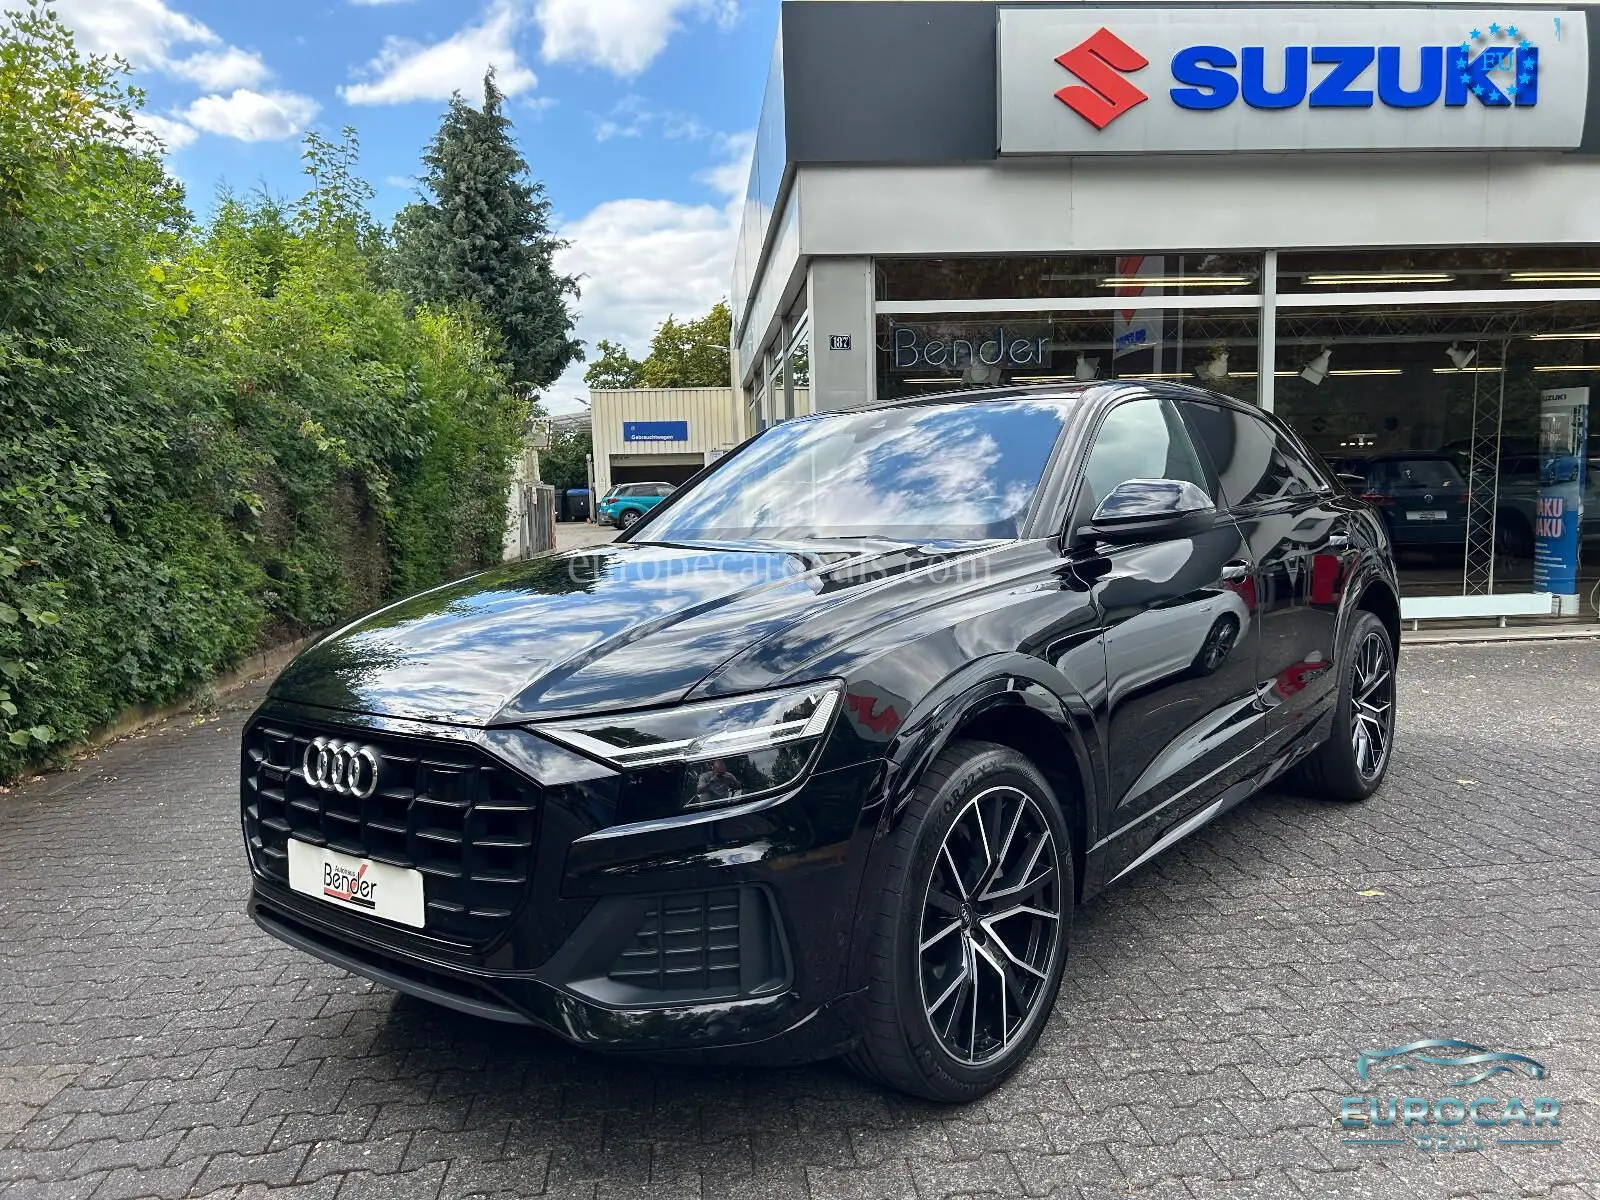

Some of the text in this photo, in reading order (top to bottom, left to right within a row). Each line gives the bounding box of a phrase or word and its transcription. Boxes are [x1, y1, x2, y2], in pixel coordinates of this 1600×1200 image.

[1170, 46, 1538, 110] SUZUKI
[833, 336, 848, 348] 187
[894, 326, 1050, 368] Bender
[324, 862, 377, 898] Bender
